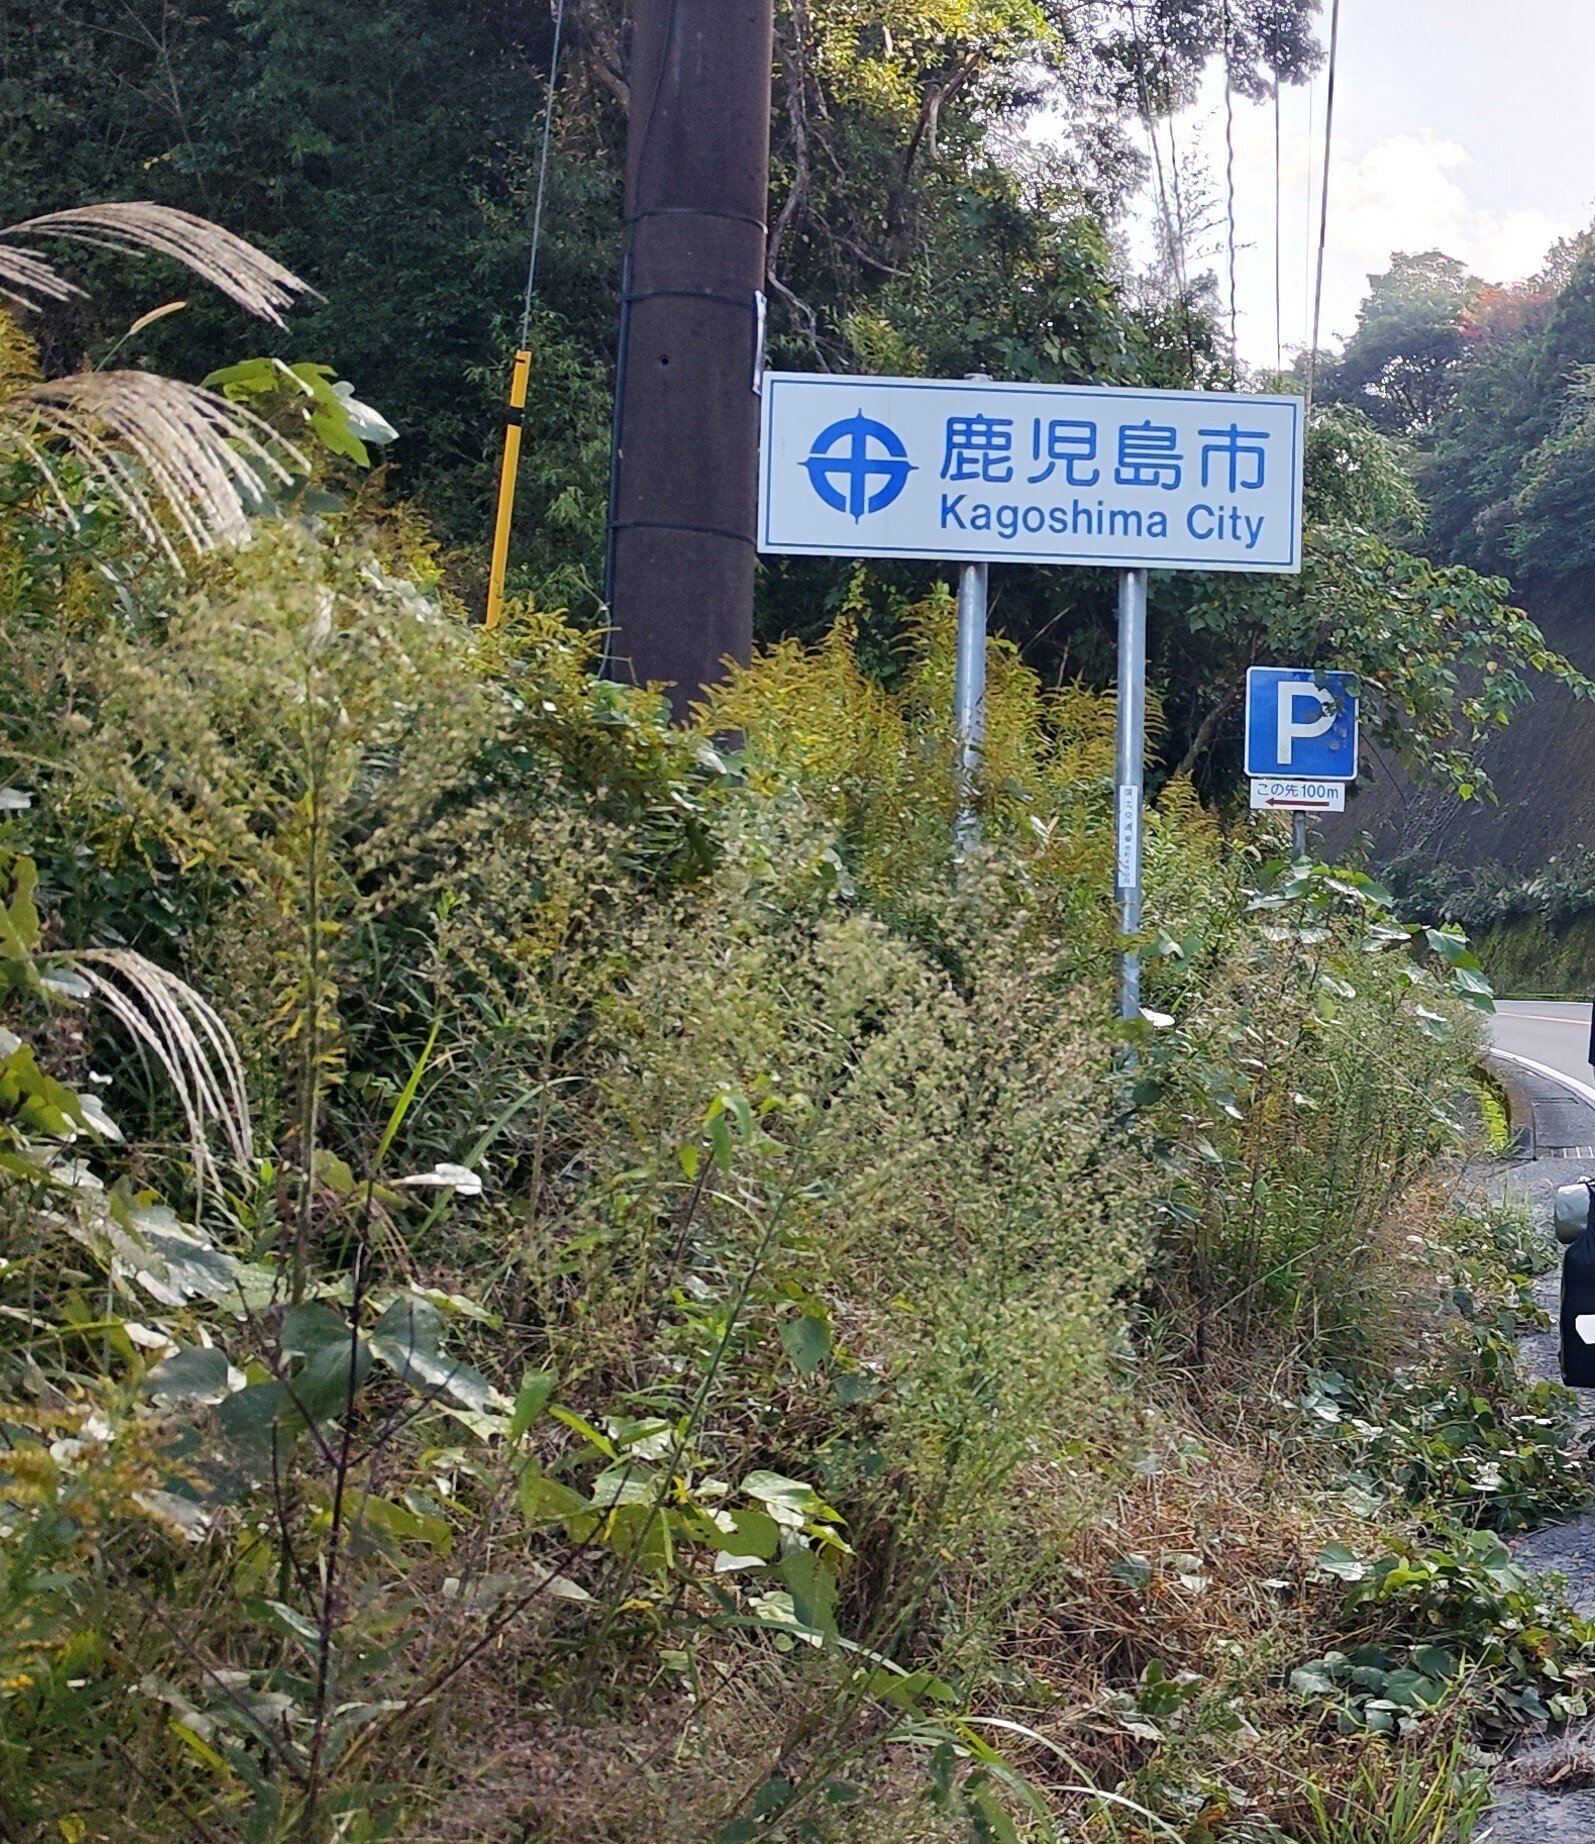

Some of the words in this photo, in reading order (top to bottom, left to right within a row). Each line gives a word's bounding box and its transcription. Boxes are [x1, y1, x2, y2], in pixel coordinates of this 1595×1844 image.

[940, 412, 1271, 493] 鹿児島市
[940, 494, 1168, 539] Kagoshima
[1186, 503, 1265, 549] City
[1276, 681, 1337, 764] P
[1257, 783, 1339, 799] この先100m
